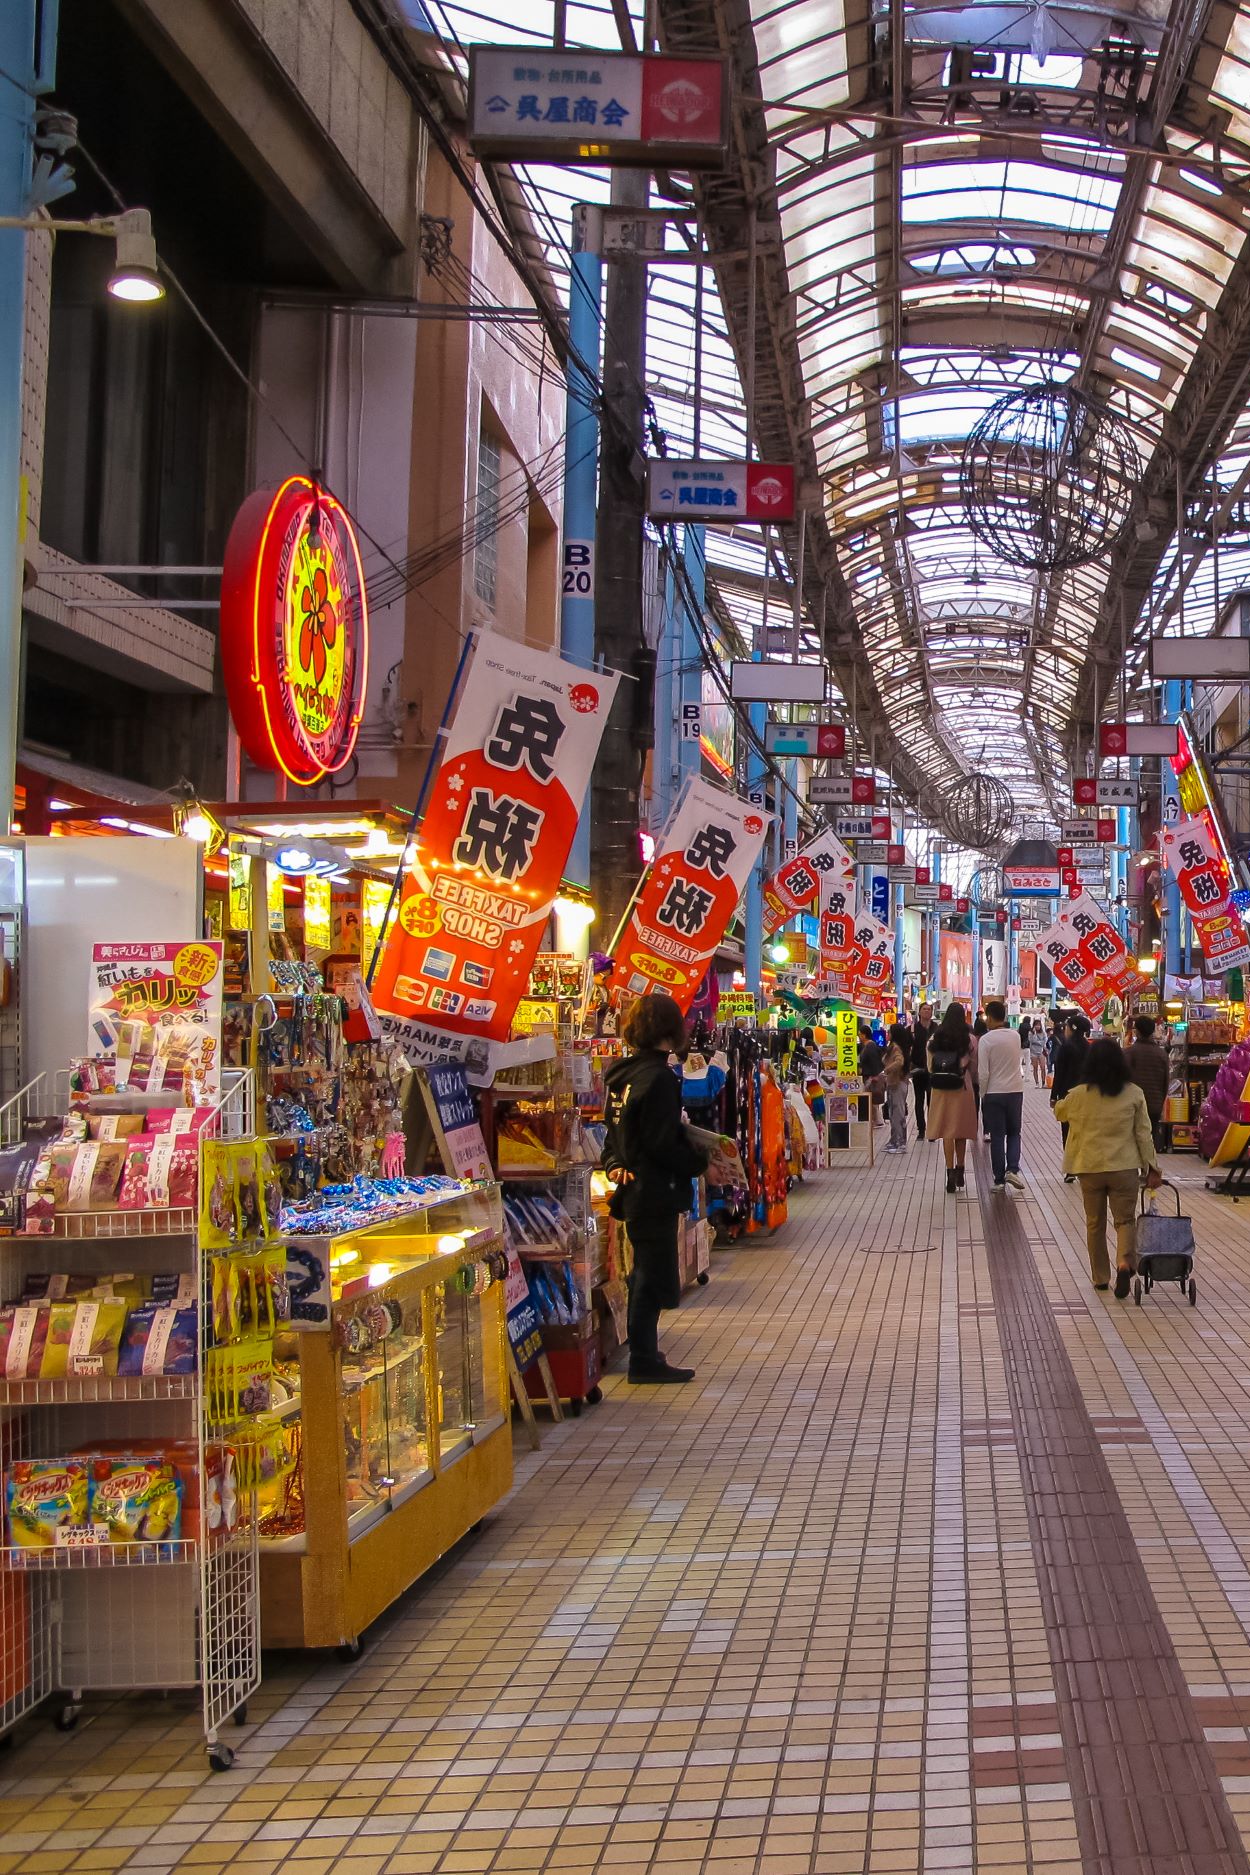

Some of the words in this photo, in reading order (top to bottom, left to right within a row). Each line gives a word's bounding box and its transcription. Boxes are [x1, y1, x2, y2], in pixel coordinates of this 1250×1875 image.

[515, 94, 631, 128] 呉屋商会
[564, 544, 590, 566] B
[562, 571, 592, 594] 20
[683, 704, 700, 720] B
[683, 723, 700, 738] 19
[750, 792, 763, 804] B
[1166, 796, 1179, 807] A
[1165, 809, 1179, 820] 17
[785, 840, 796, 850] B
[1178, 839, 1221, 904] 免税
[1071, 912, 1118, 963] 免税
[1046, 940, 1088, 984] 免税
